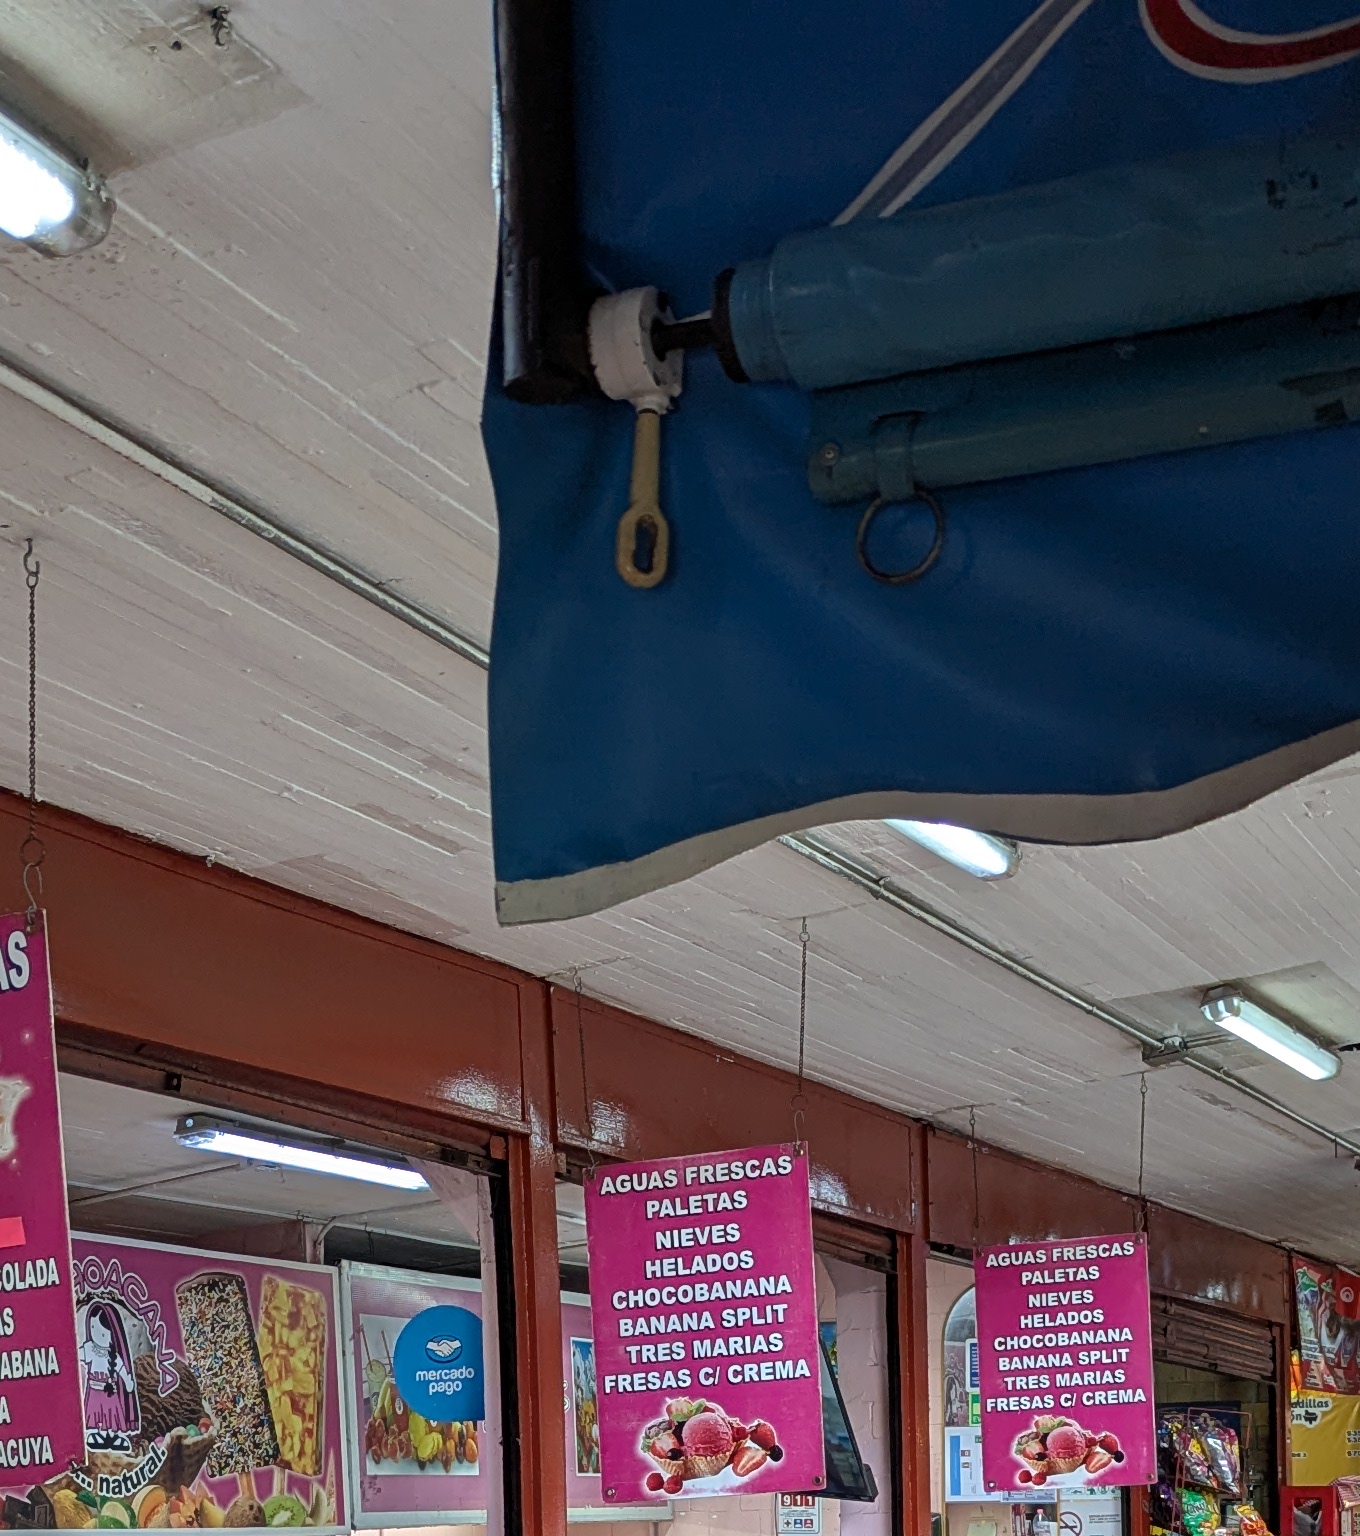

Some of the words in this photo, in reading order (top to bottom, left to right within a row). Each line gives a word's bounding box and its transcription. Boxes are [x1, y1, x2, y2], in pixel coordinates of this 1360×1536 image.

[600, 1169, 678, 1195] AGUAS
[685, 1155, 793, 1187] FRESCAS
[646, 1190, 747, 1219] PALETAS
[655, 1223, 740, 1250] NIEVES
[645, 1250, 754, 1279] HELADOS
[986, 1249, 1047, 1267] AGUAS
[1052, 1241, 1135, 1262] FRESCAS
[1021, 1266, 1100, 1285] PALETAS
[612, 1274, 793, 1310] CHOCOBANANA
[1028, 1290, 1094, 1308] NIEVES
[619, 1310, 715, 1338] BANANA
[721, 1303, 789, 1328] SPLIT
[1020, 1309, 1104, 1329] HELADOS
[626, 1342, 686, 1364] TRES
[693, 1333, 784, 1360] MARIAS
[993, 1327, 1133, 1351] CHOCOBANANA
[998, 1352, 1073, 1371] BANANA
[1078, 1348, 1130, 1366] SPLIT
[416, 1366, 475, 1381] mercado
[604, 1369, 692, 1393] FRESAS
[698, 1366, 720, 1387] C/
[727, 1359, 811, 1382] CREMA
[1004, 1375, 1050, 1391] TRES
[1055, 1369, 1126, 1388] MARIAS
[428, 1379, 463, 1396] pago
[986, 1394, 1055, 1412] FRESAS
[1060, 1393, 1077, 1408] C/
[1082, 1389, 1146, 1406] CREMA
[781, 1494, 815, 1507] 911
